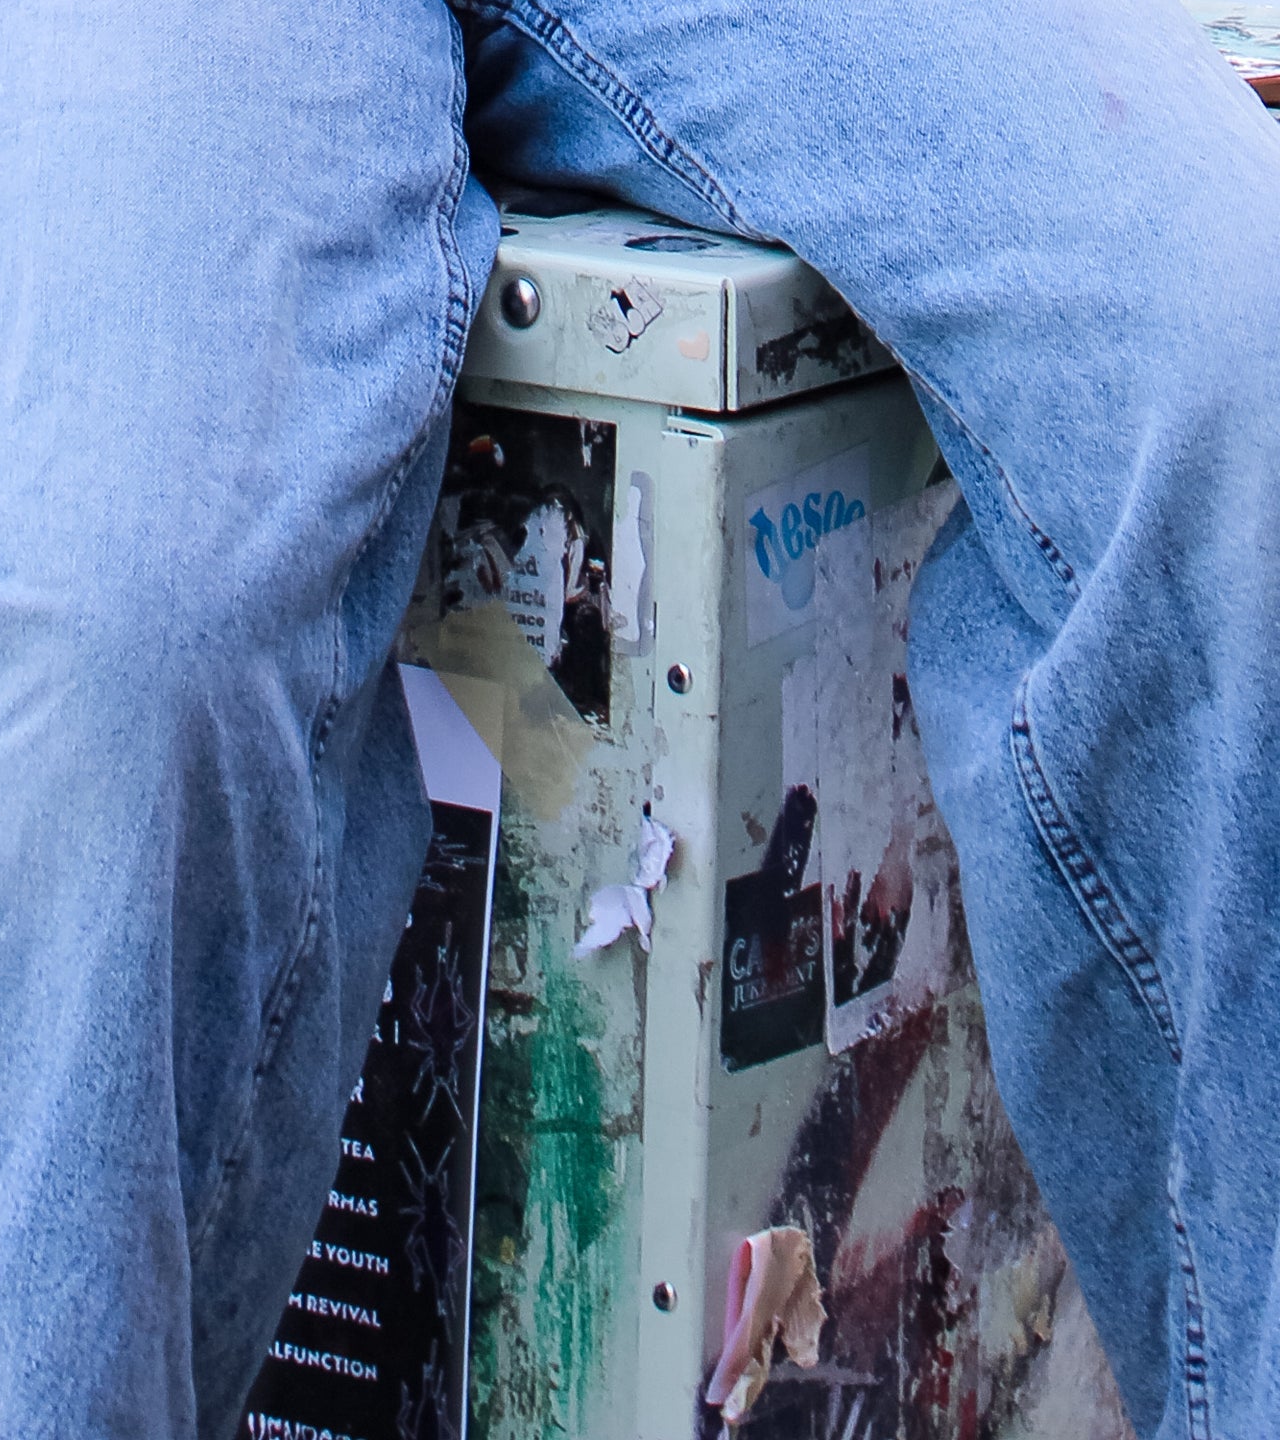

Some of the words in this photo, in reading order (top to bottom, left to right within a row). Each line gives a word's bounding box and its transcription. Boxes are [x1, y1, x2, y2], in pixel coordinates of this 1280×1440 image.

[328, 1189, 379, 1218] RMAS
[325, 1243, 390, 1275] YOUTH
[307, 1294, 382, 1329] REVIVAL
[269, 1340, 378, 1381] LFUNCTION
